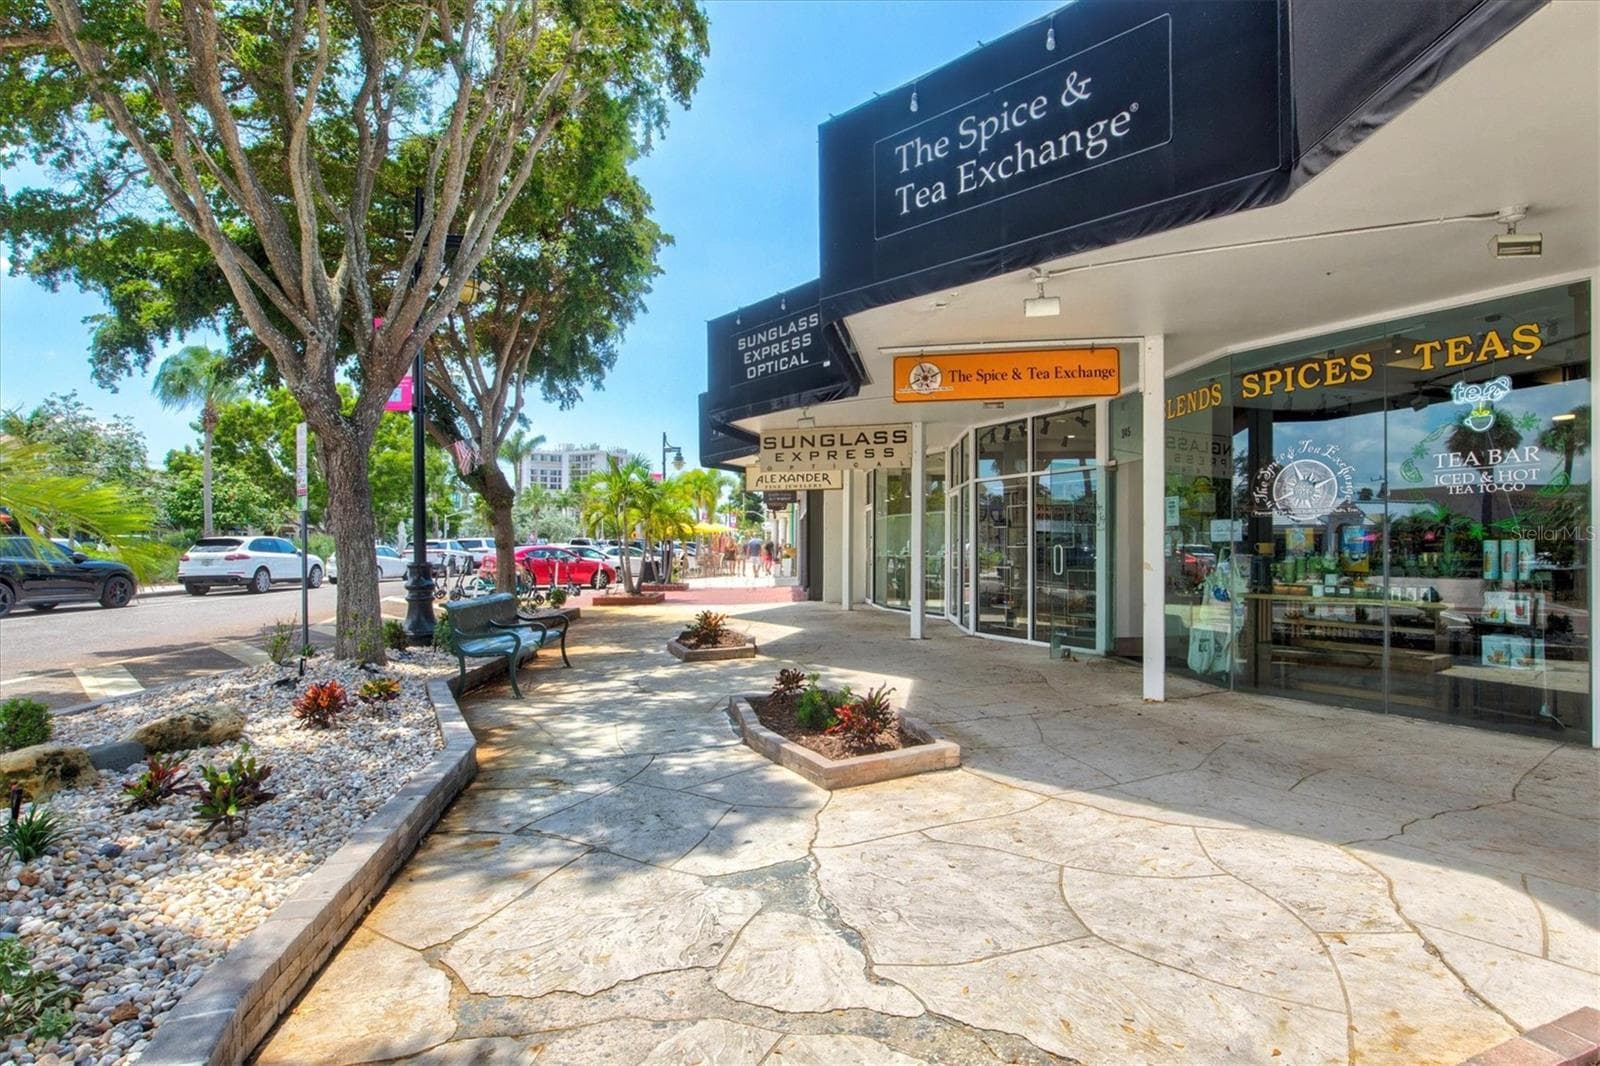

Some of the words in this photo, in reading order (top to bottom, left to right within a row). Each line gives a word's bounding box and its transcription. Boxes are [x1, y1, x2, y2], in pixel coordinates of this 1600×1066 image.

[895, 133, 950, 174] The
[958, 95, 1048, 153] Spice
[1060, 71, 1092, 107] &
[895, 181, 947, 215] Tea
[738, 313, 819, 350] SUNGLASS
[744, 333, 812, 364] EXPRESS
[1413, 323, 1543, 371] TEAS
[747, 352, 809, 379] OPTICAL
[948, 369, 973, 383] The
[975, 366, 1009, 384] Spice
[1012, 368, 1022, 380] &
[1027, 367, 1051, 380] Tea
[1055, 364, 1117, 380] Exchange
[1165, 383, 1223, 420] LENDS
[1241, 352, 1374, 399] SPICES
[763, 430, 908, 450] SUNGLASS
[766, 461, 905, 472] OPTICAL
[775, 448, 895, 463] EXPRESS
[1433, 451, 1481, 469] TEA
[1488, 445, 1540, 465] BAR
[755, 473, 832, 488] ALEXANDER
[1298, 440, 1322, 454] Tea
[1321, 443, 1357, 504] Exchange
[1434, 472, 1475, 486] ICED
[1480, 471, 1494, 483] &
[1498, 468, 1540, 482] HOT
[1447, 485, 1475, 495] TEA
